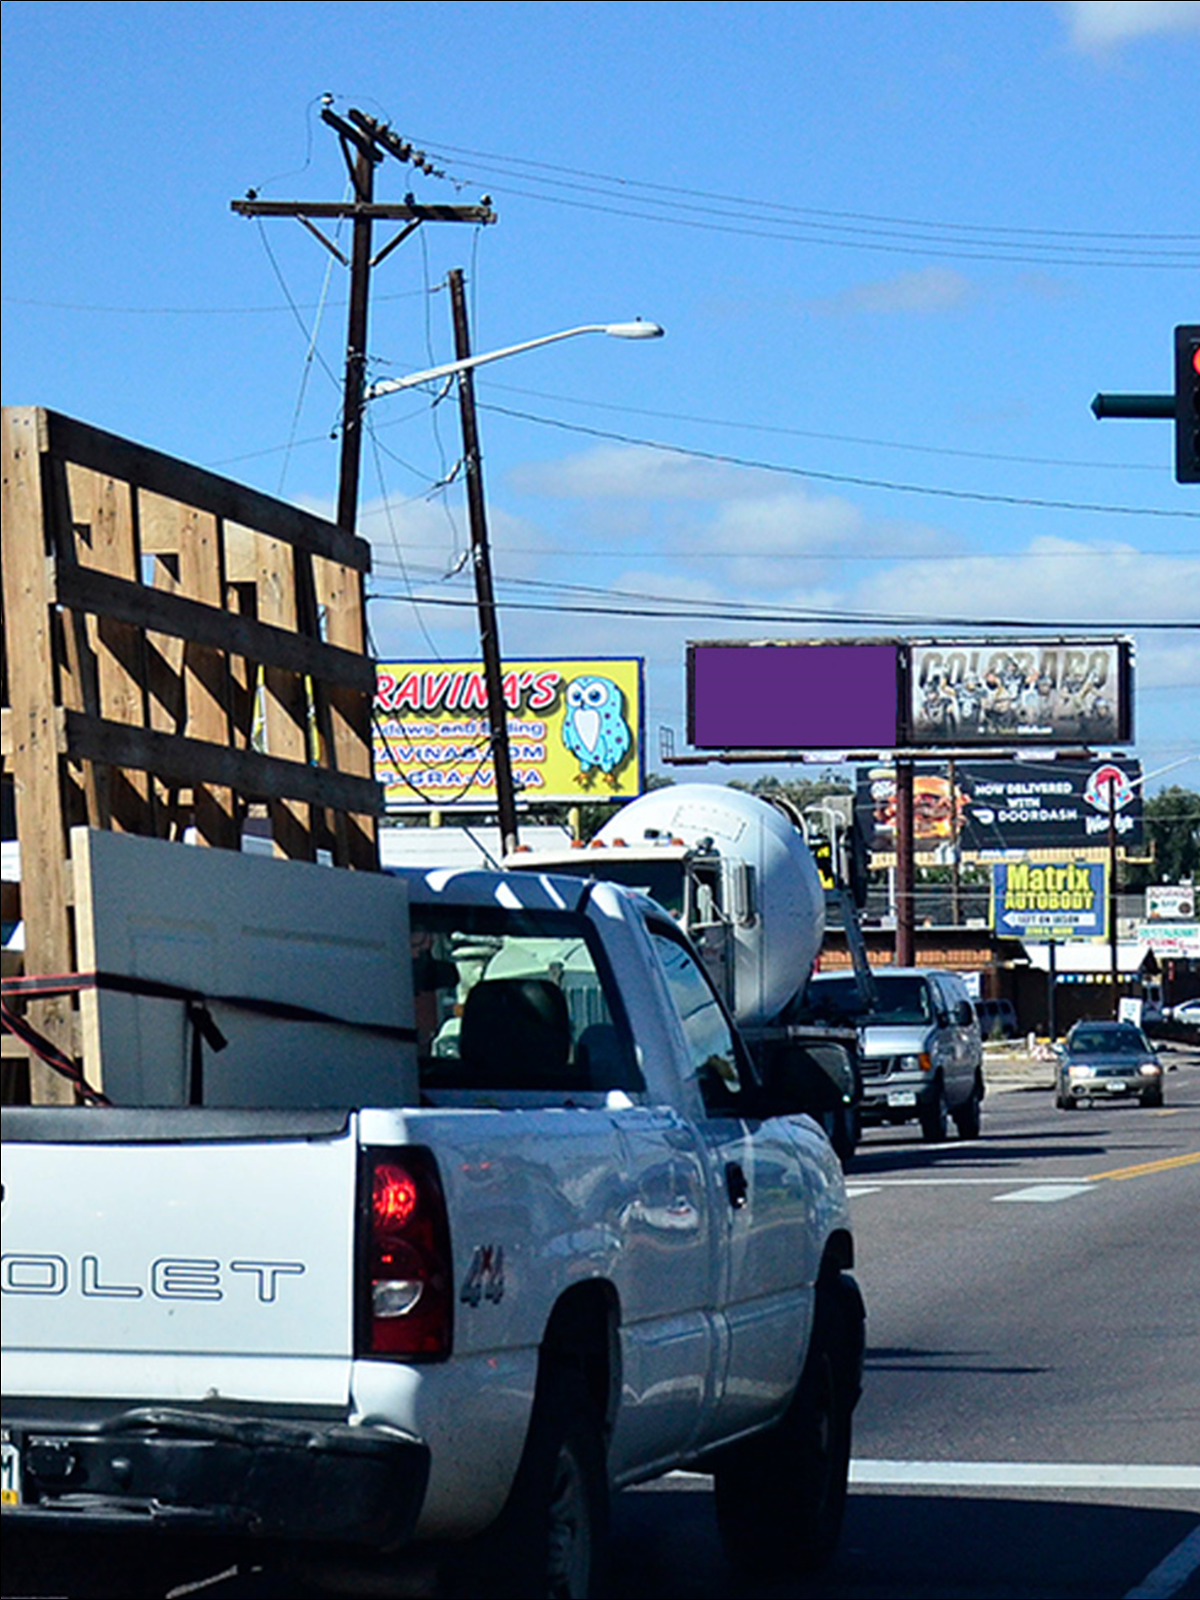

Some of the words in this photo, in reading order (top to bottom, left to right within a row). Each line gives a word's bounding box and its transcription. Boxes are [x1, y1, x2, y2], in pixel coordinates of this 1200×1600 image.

[974, 783, 1004, 795] NOW
[1006, 781, 1073, 795] DELIVERED
[1006, 797, 1041, 808] WITH
[997, 808, 1078, 822] DOORDASH
[1007, 863, 1091, 891] Matrix
[1004, 891, 1095, 910] AUTOBODY
[1, 1252, 306, 1303] OLET
